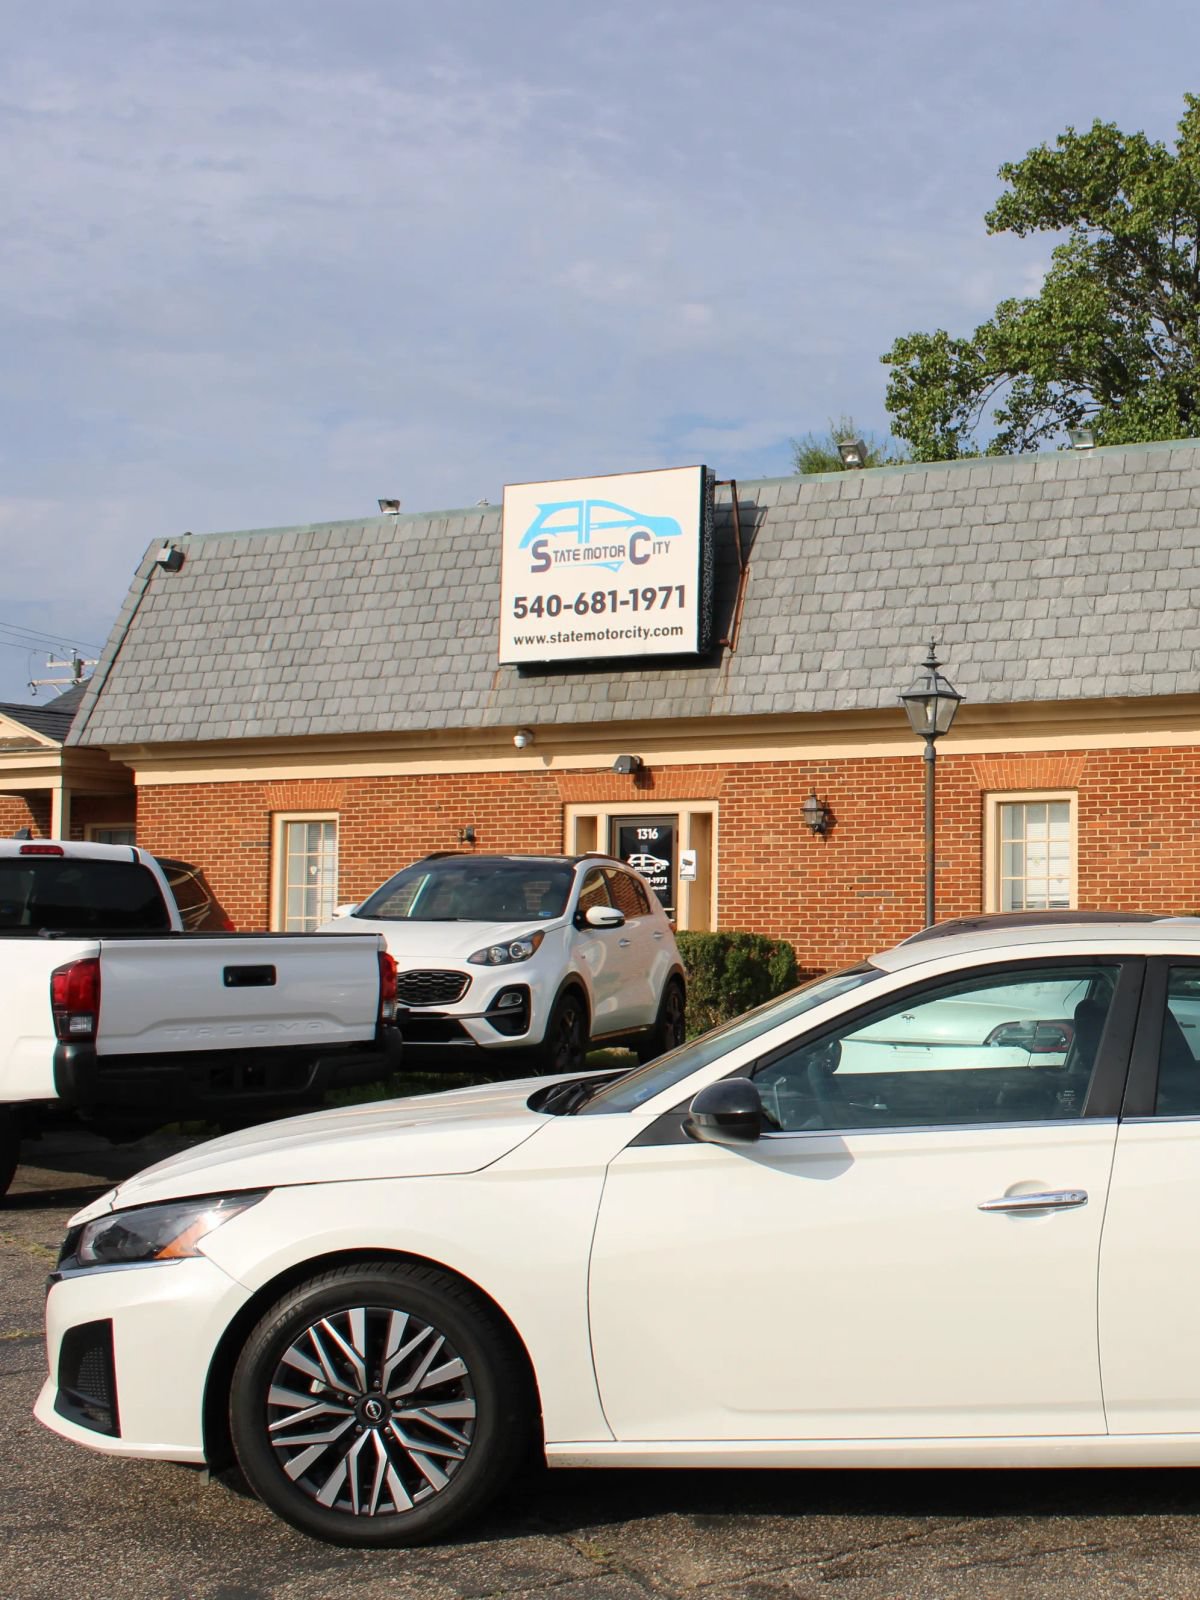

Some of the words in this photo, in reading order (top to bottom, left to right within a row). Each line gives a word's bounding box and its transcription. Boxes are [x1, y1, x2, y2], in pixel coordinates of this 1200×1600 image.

[530, 539, 581, 573] STATE
[583, 545, 626, 560] MOTOR
[629, 531, 671, 565] CITY
[513, 585, 685, 619] 540-681-1971
[513, 625, 684, 645] www.statemotorcity.com
[636, 828, 659, 840] 1316
